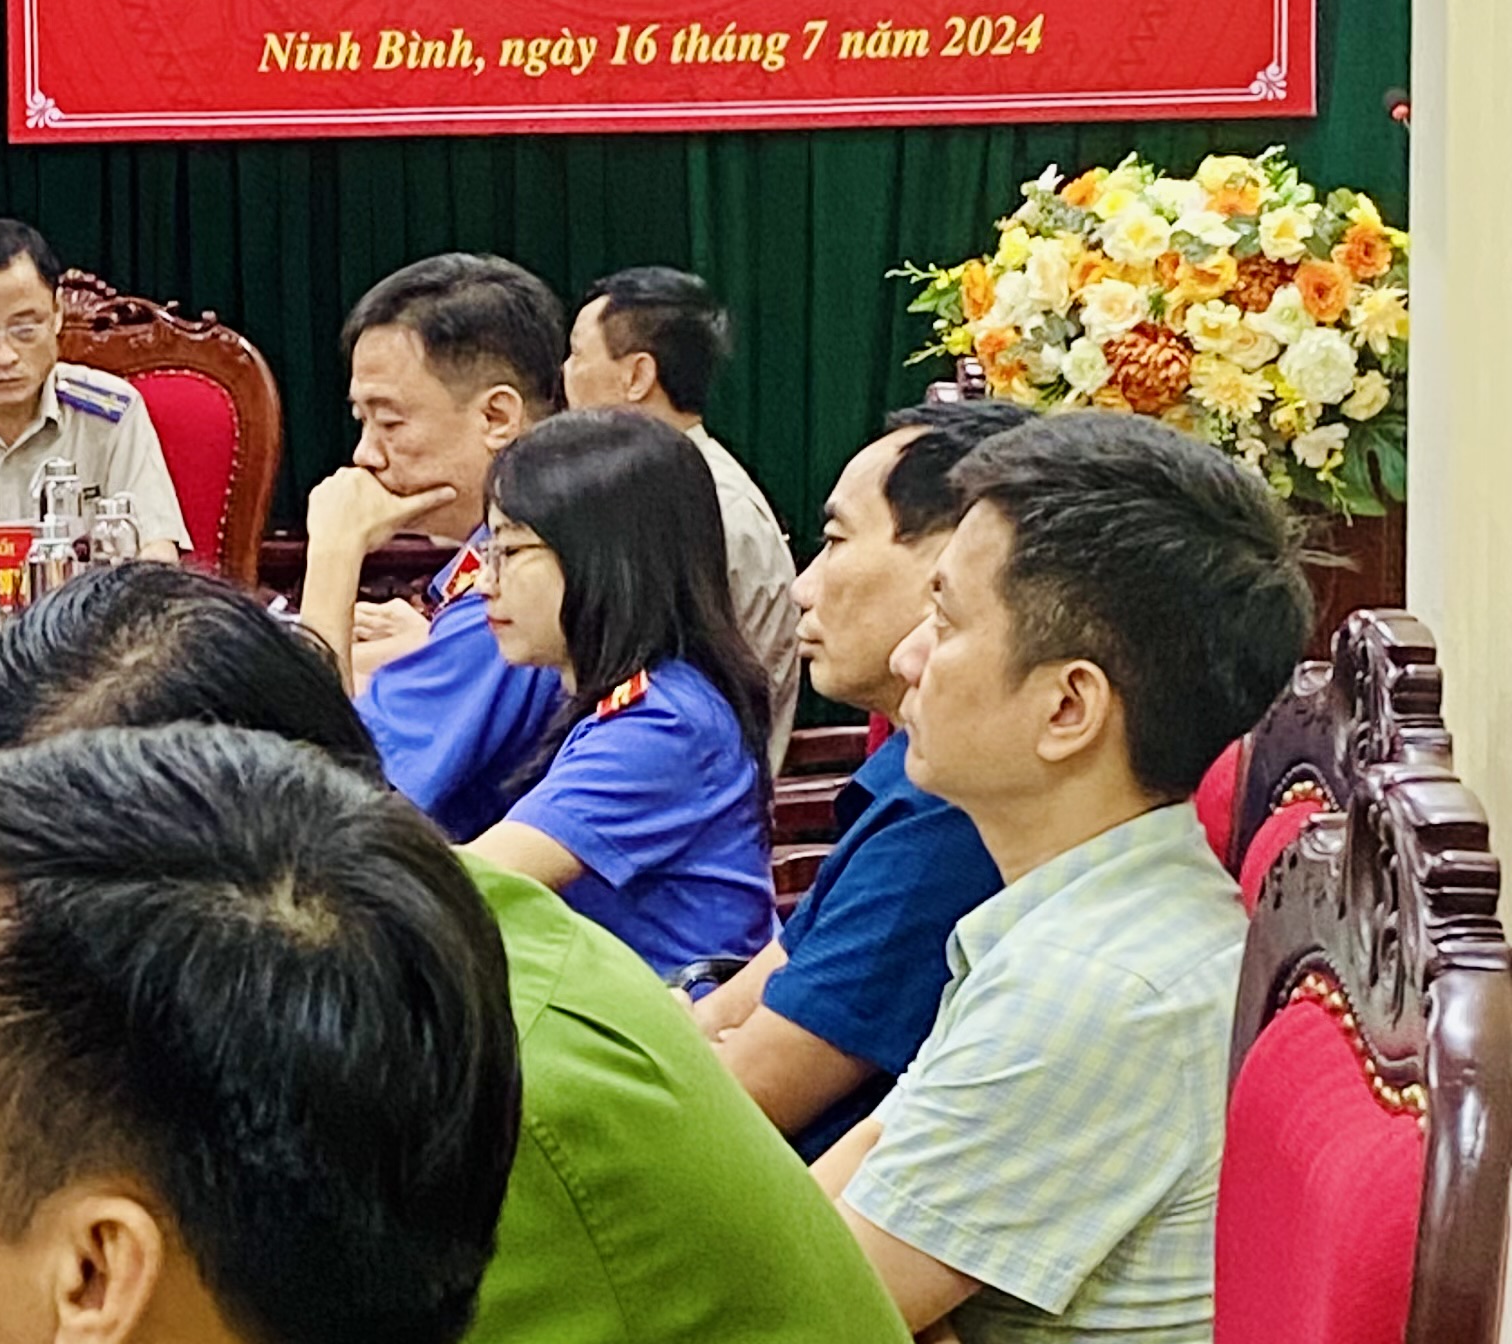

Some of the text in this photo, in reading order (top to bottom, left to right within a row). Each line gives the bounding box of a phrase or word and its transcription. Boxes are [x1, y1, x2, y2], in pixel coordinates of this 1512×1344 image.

[258, 14, 1044, 76] Ninh Bình, ngày 16 tháng 7 năm 2024
